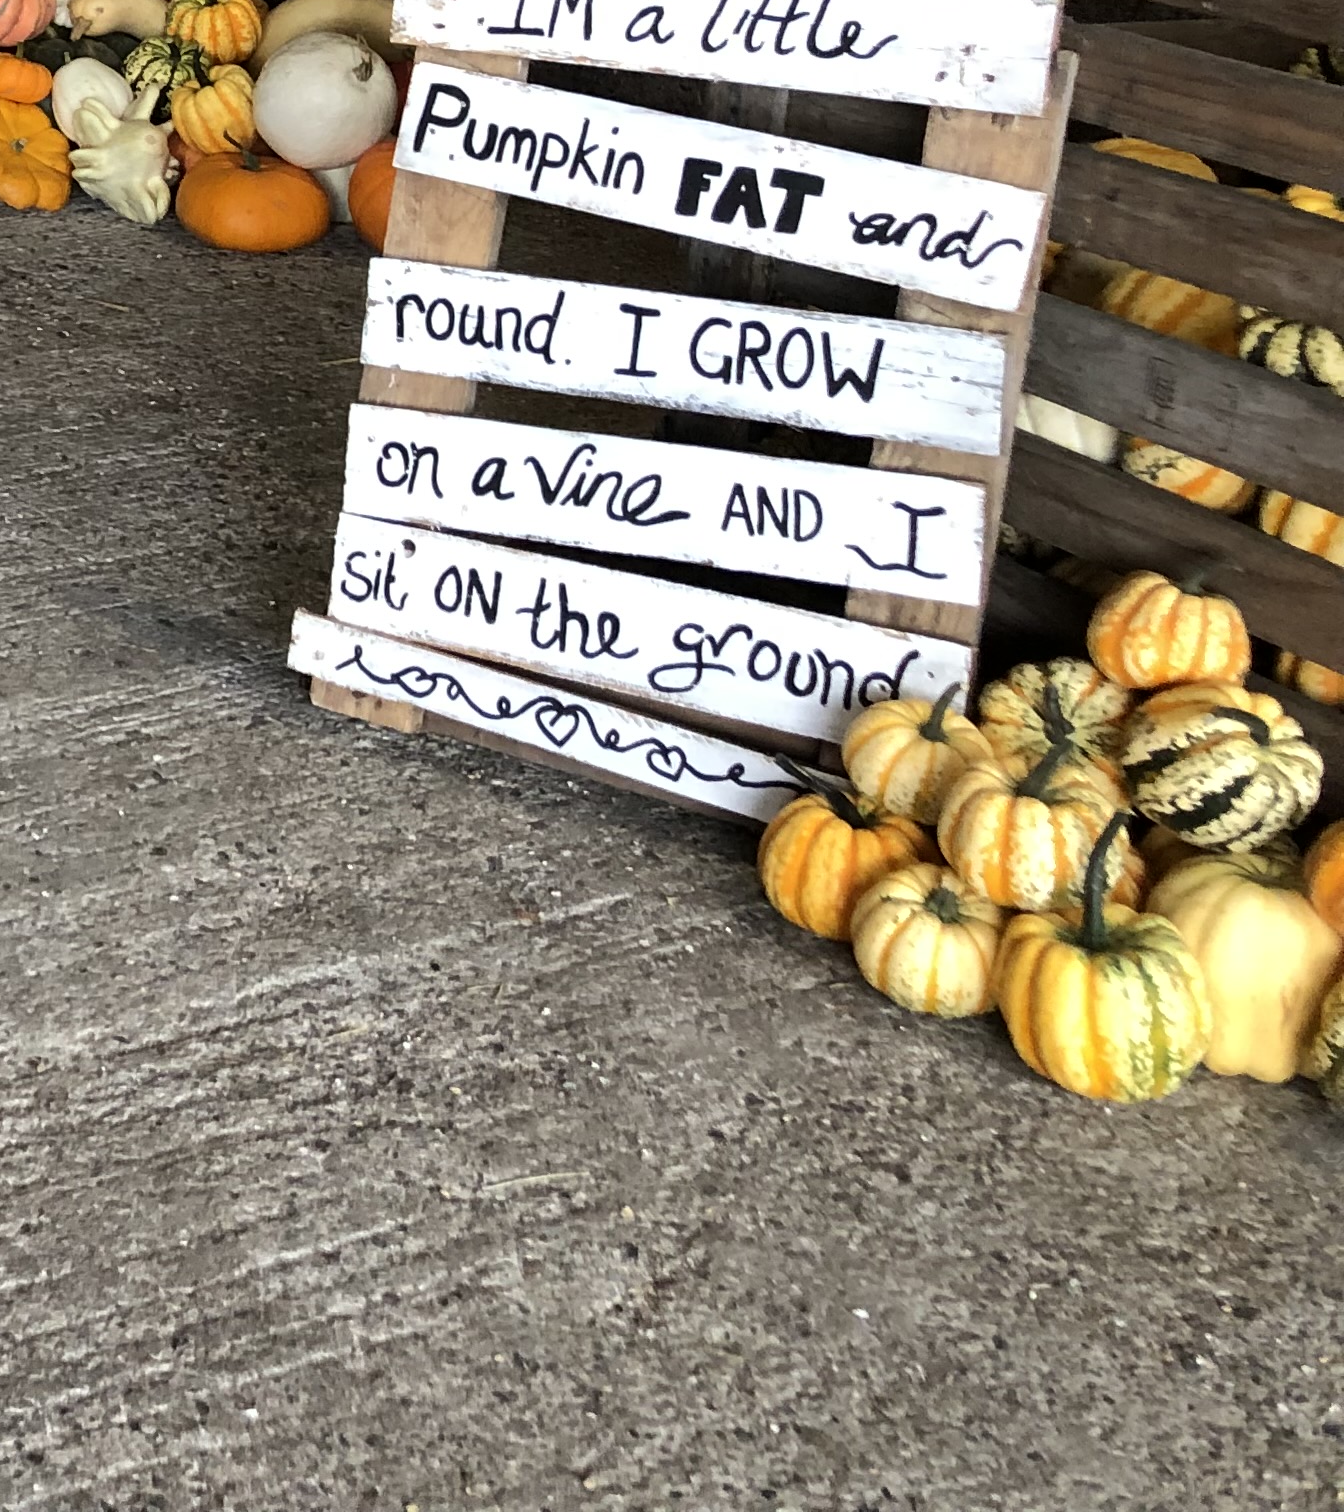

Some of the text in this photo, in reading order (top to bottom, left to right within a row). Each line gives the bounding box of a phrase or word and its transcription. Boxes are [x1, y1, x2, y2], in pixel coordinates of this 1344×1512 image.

[625, 6, 675, 44] a
[413, 82, 1023, 269] Pumpkin FAT and
[613, 303, 662, 378] I
[689, 316, 886, 403] GROW
[374, 442, 444, 498] on
[471, 456, 515, 500] a
[720, 482, 824, 542] AND
[844, 500, 949, 579] I
[434, 565, 502, 626] ON
[517, 576, 639, 659] the
[649, 621, 921, 711] ground
